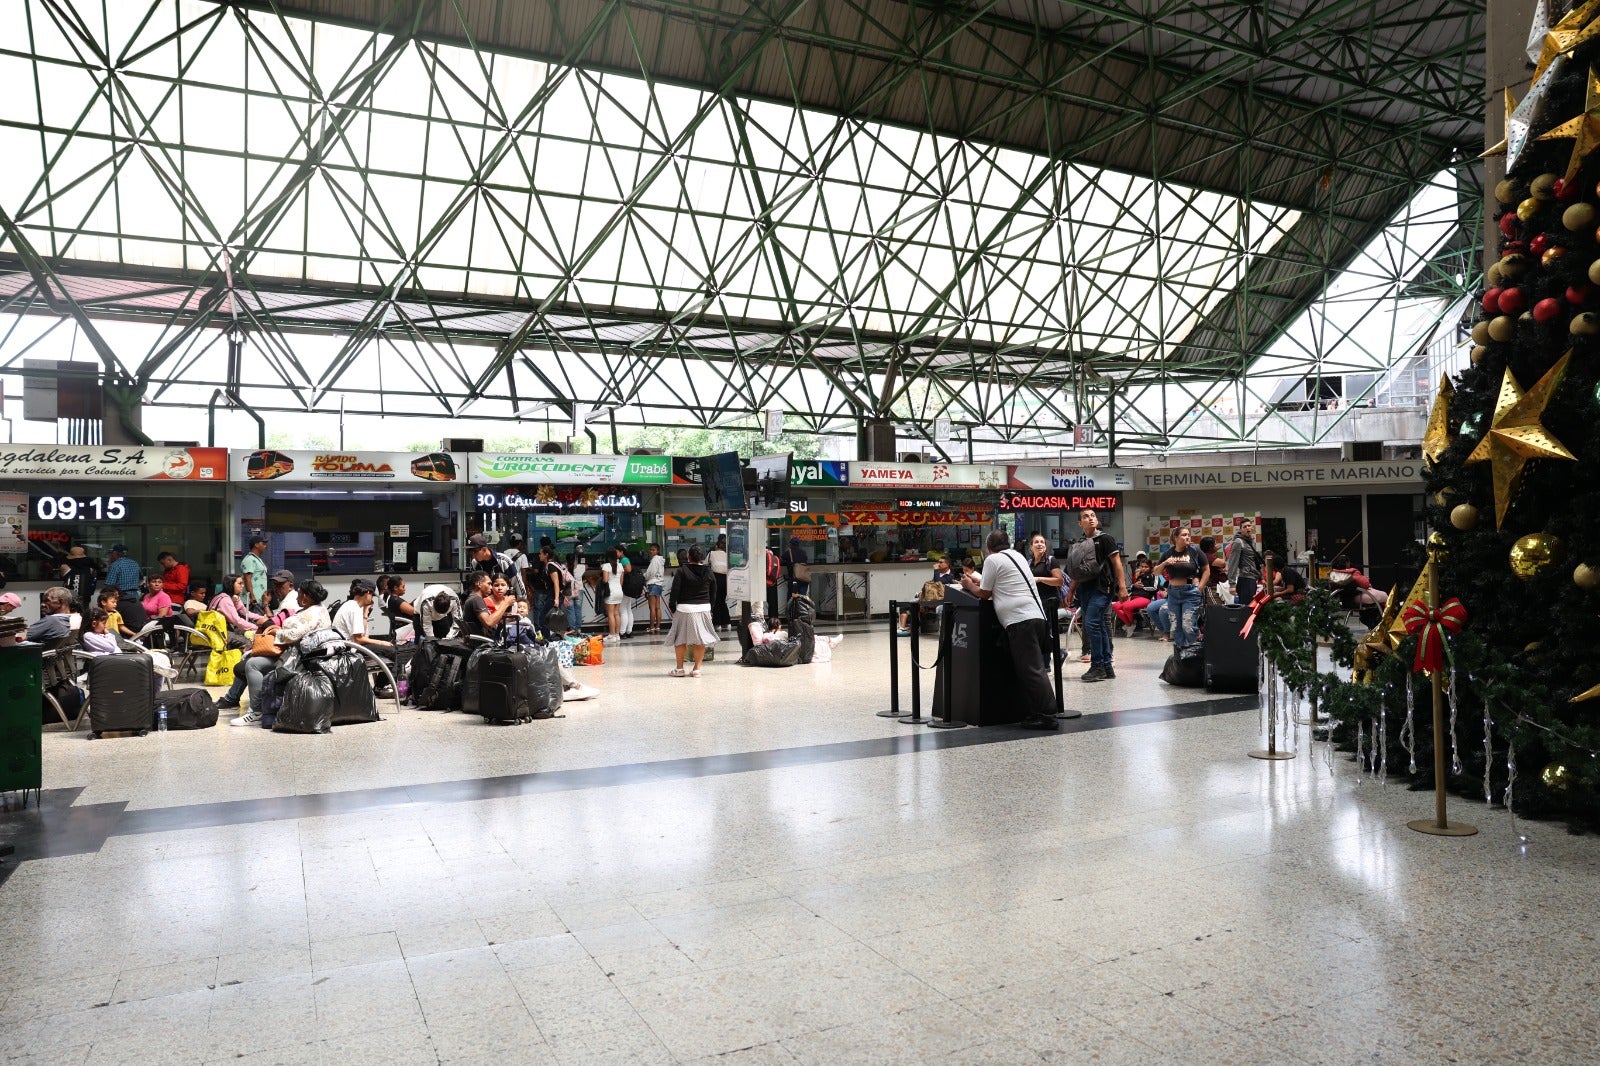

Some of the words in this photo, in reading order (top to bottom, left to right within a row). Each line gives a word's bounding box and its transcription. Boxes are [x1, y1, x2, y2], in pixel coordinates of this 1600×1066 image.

[1081, 429, 1092, 442] 31
[0, 449, 92, 467] gdalena
[99, 449, 148, 464] S.A.
[59, 468, 80, 476] por
[85, 466, 137, 475] Colombia
[630, 463, 668, 474] Urabá
[861, 469, 913, 479] YAMEYA
[1051, 476, 1095, 488] brasilia
[1145, 473, 1226, 486] TERMINAL
[1231, 470, 1262, 483] DEL
[1267, 468, 1325, 482] NORTE
[1330, 465, 1415, 480] MARIANO
[37, 496, 125, 519] 09:15
[790, 500, 808, 512] su
[1012, 496, 1070, 510] CAUCASIA,
[841, 511, 993, 525] YARUMAL
